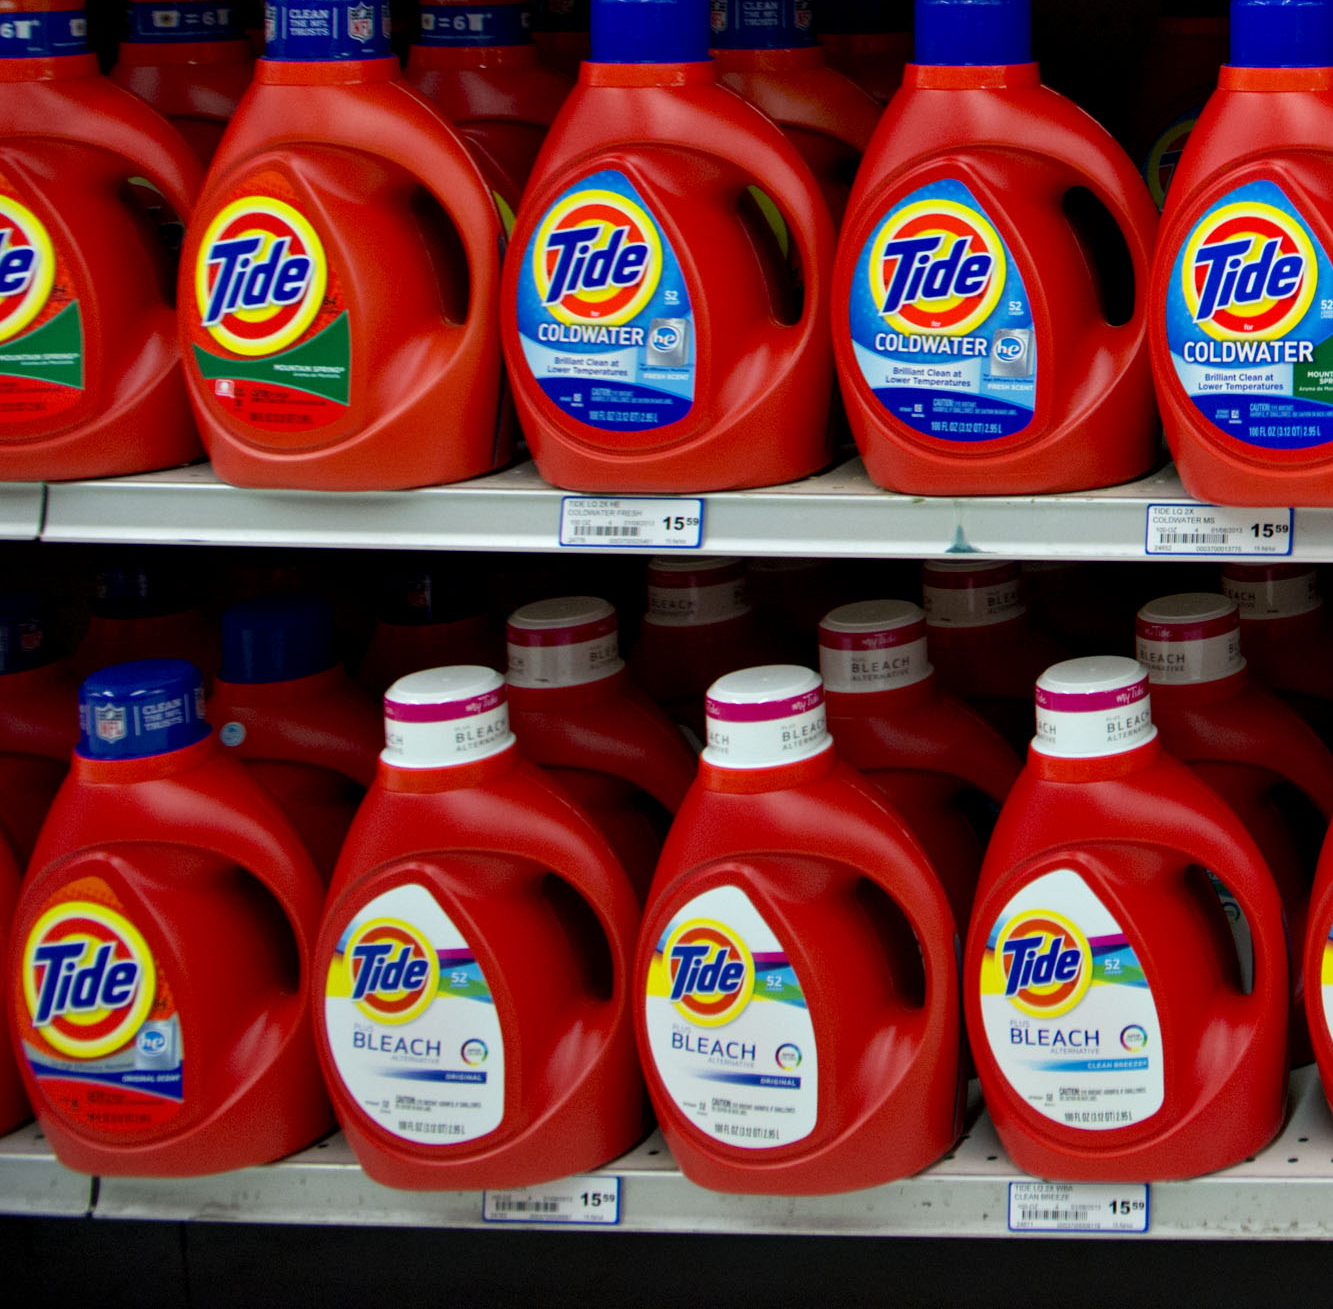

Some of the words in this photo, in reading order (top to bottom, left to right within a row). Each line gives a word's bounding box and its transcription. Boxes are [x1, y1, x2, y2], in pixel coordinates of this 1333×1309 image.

[541, 226, 650, 307] Tide
[878, 234, 993, 316] Tide
[202, 235, 314, 327] Tide
[1193, 236, 1304, 324] Tide
[1320, 299, 1333, 311] 52
[538, 323, 644, 346] COLDWATER
[875, 333, 987, 356] COLDWATER
[1183, 341, 1314, 363] COLDWATER
[1198, 381, 1223, 391] Lower
[1225, 382, 1284, 392] Temperatures
[1204, 373, 1238, 382] Brilliant
[1240, 373, 1261, 382] Clean
[350, 943, 430, 1001] Tide
[670, 944, 746, 1001] Tide
[1001, 934, 1082, 996] Tide
[1104, 958, 1121, 970] 52
[32, 944, 138, 1027] Tide
[766, 976, 782, 988] 52
[353, 1031, 442, 1057] BLEACH
[672, 1032, 756, 1061] BLEACH
[1010, 1027, 1100, 1048] BLEACH
